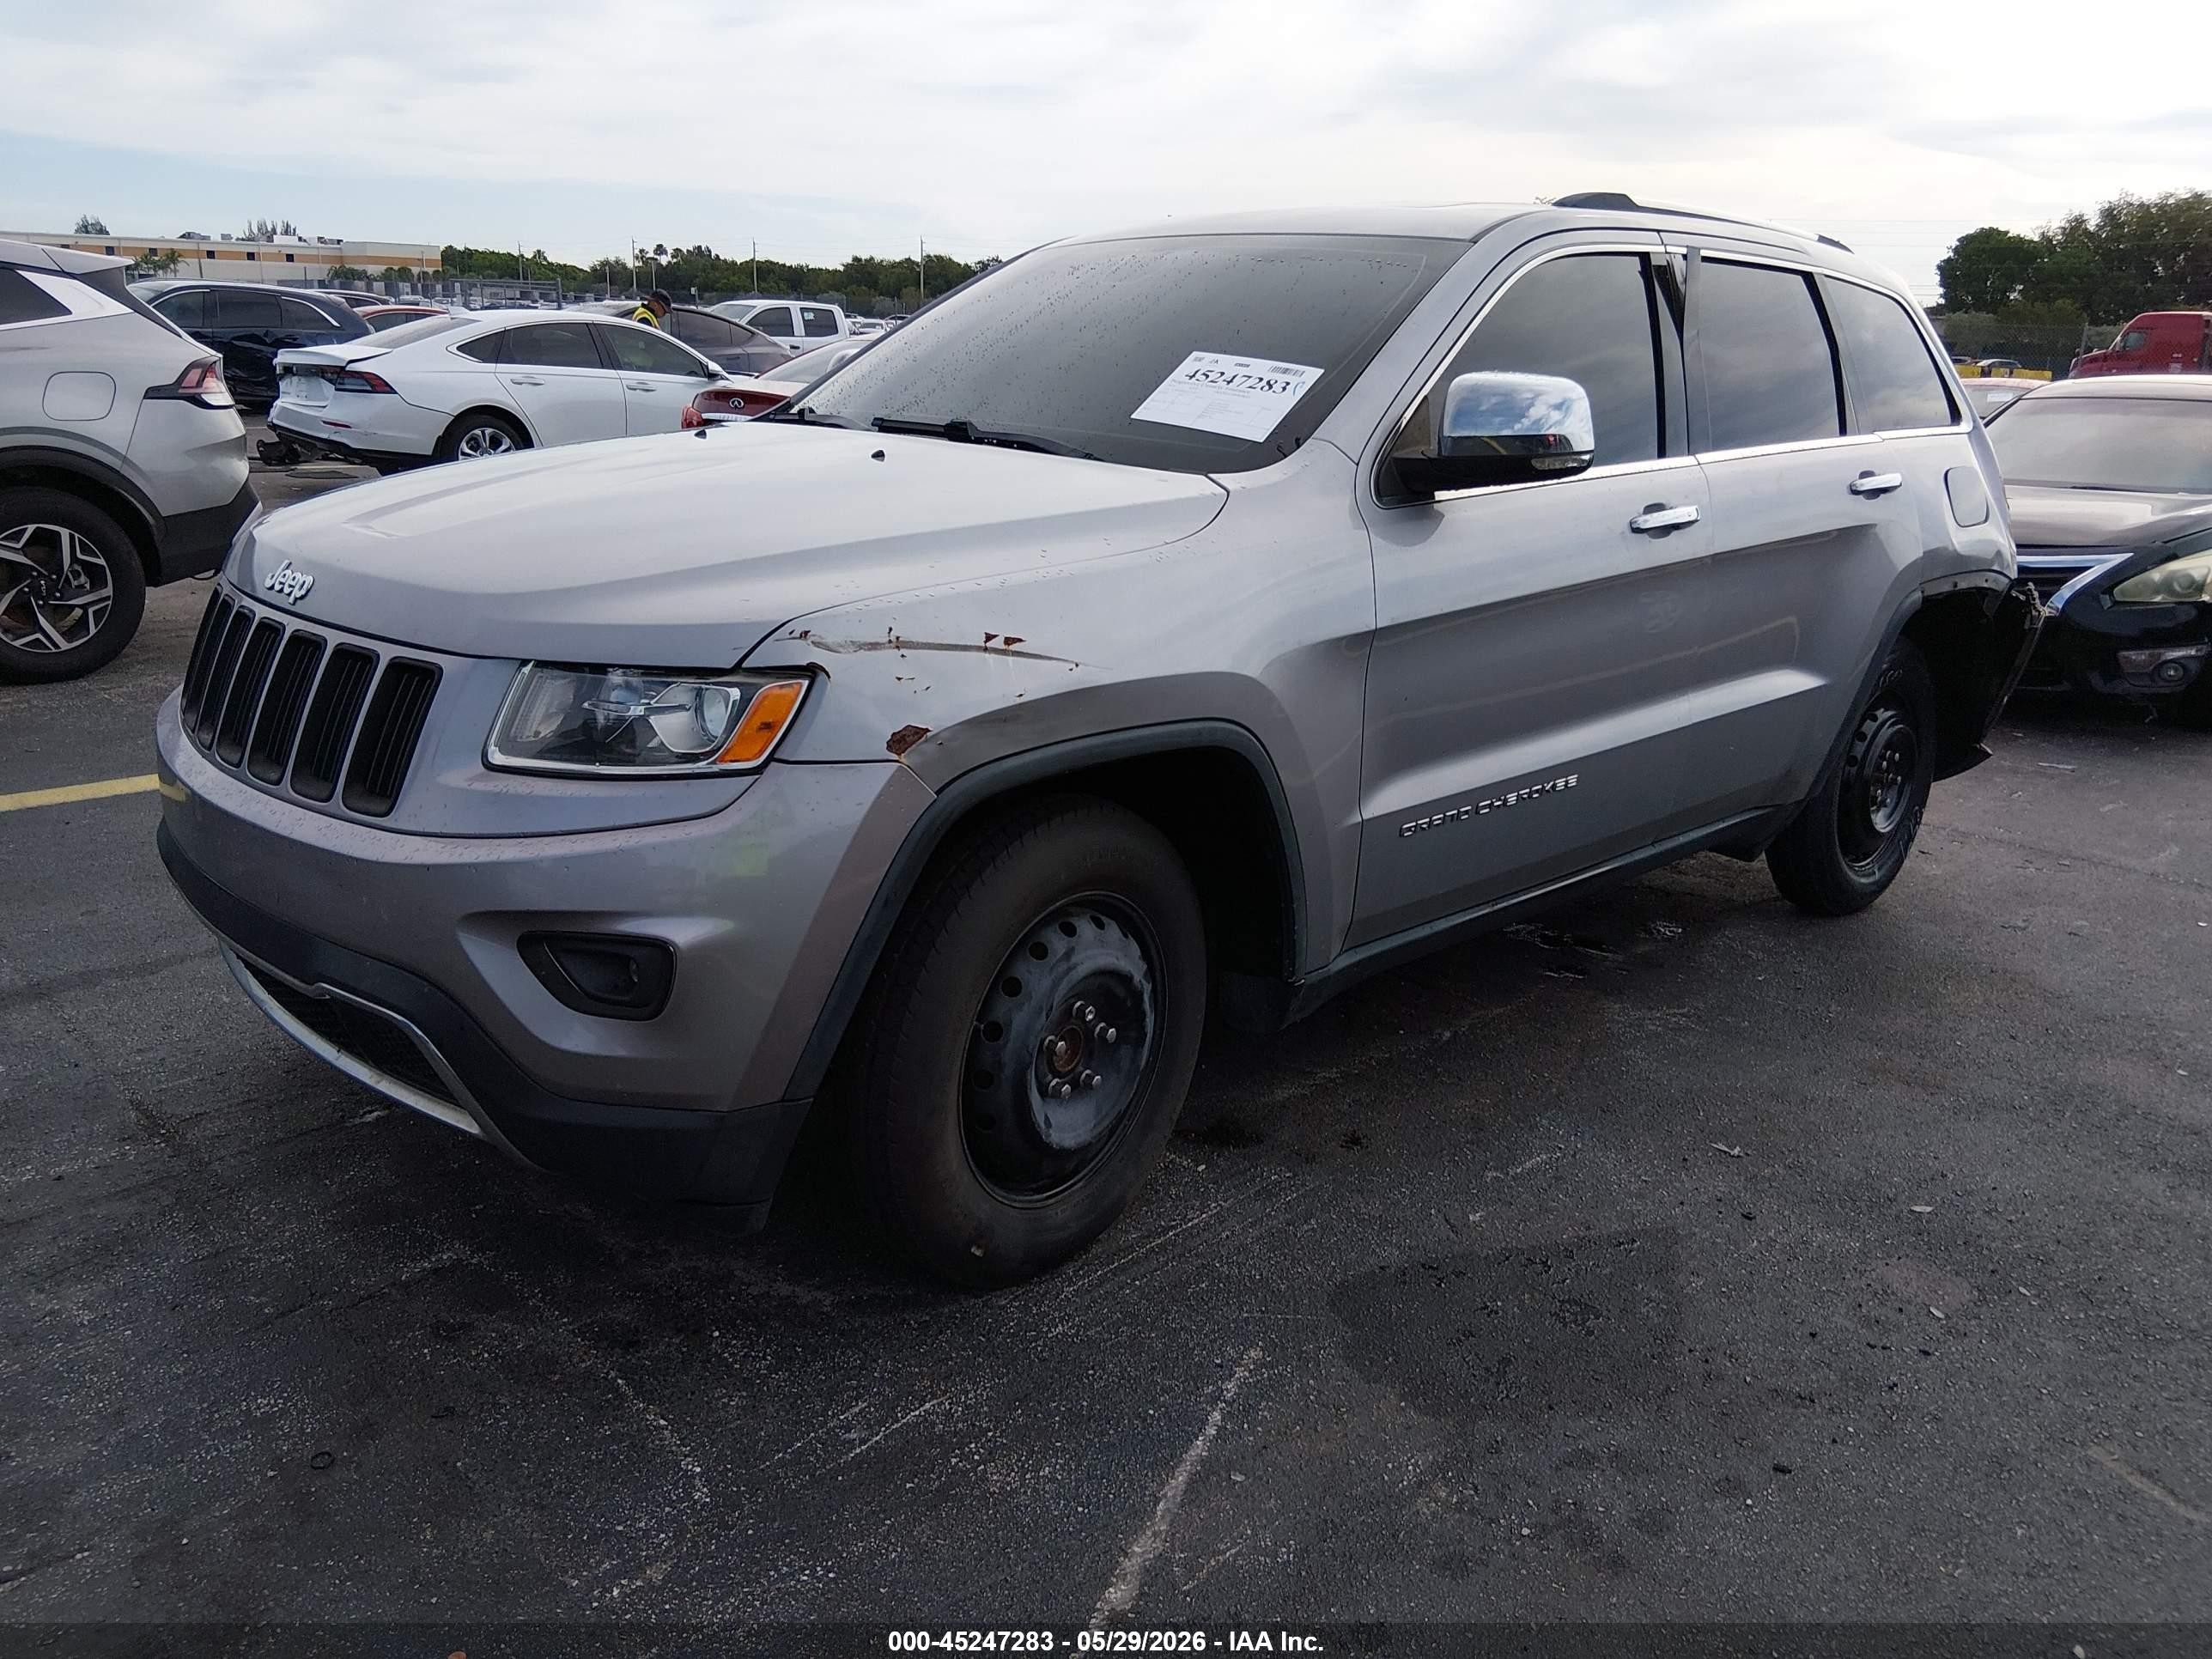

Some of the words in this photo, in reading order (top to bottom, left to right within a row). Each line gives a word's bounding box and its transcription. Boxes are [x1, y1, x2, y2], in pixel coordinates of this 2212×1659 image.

[1184, 368, 1291, 395] 45247283
[264, 560, 313, 605] Jeep
[1400, 805, 1472, 837] GRAND
[1476, 775, 1578, 815] CHEROKEE
